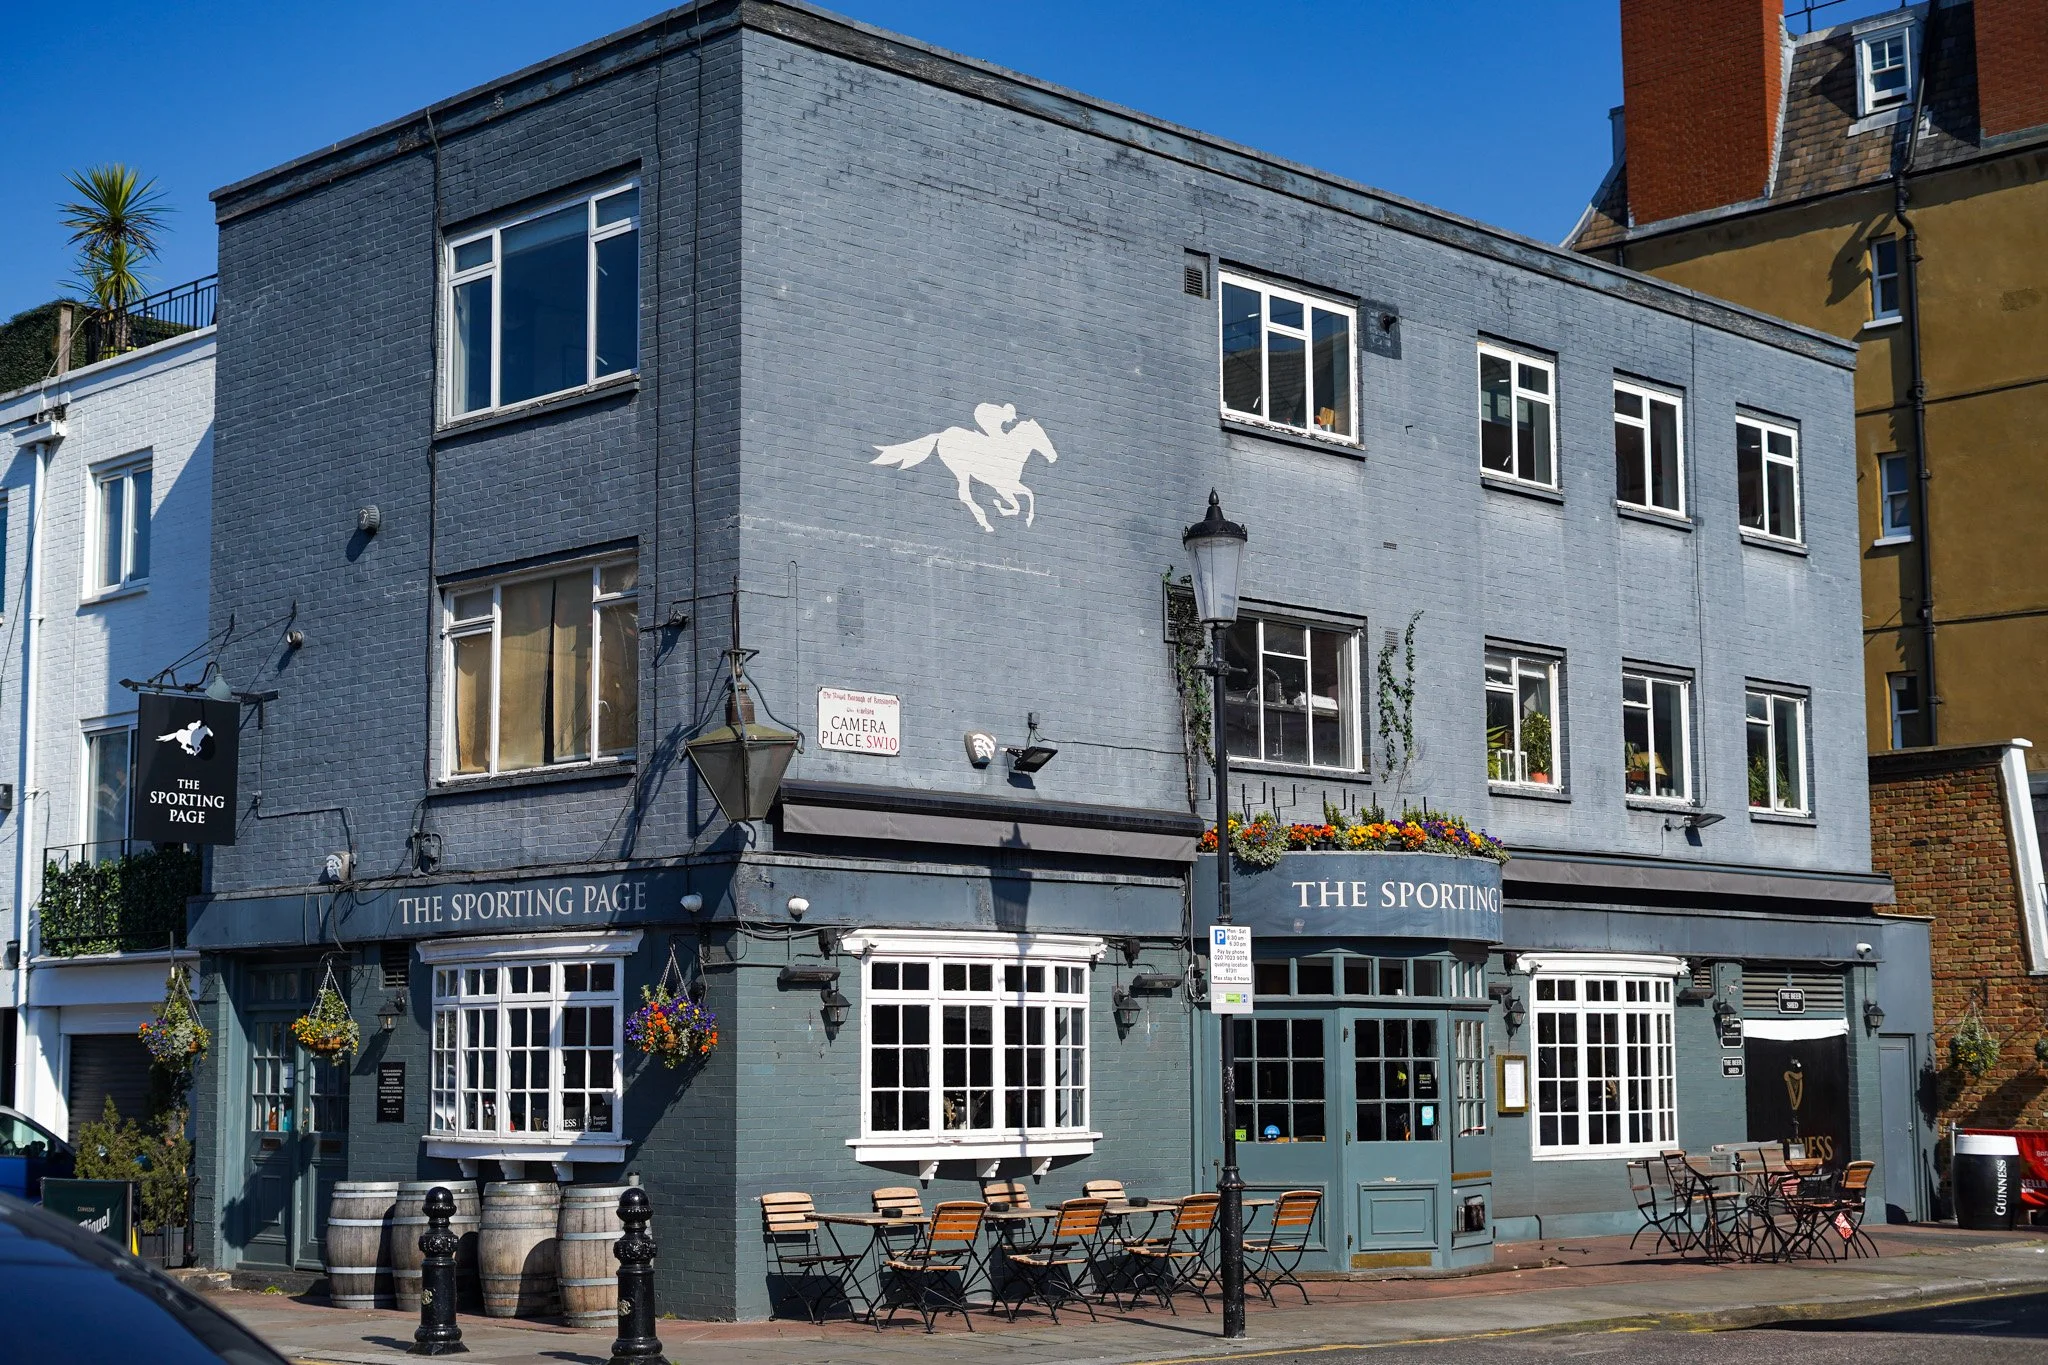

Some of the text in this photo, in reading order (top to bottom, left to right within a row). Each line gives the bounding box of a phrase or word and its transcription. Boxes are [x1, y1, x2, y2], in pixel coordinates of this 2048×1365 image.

[831, 715, 887, 734] CAMERA
[177, 779, 200, 790] THE
[150, 791, 225, 809] SPORTING
[169, 809, 205, 824] PAGE
[399, 881, 647, 924] THE SPORTING PAGE
[1291, 881, 1368, 908] THE
[1381, 881, 1497, 913] SPORTING
[1781, 992, 1791, 1000] THE
[1786, 1001, 1799, 1009] SHED
[1995, 1159, 2008, 1216] GUINNESS
